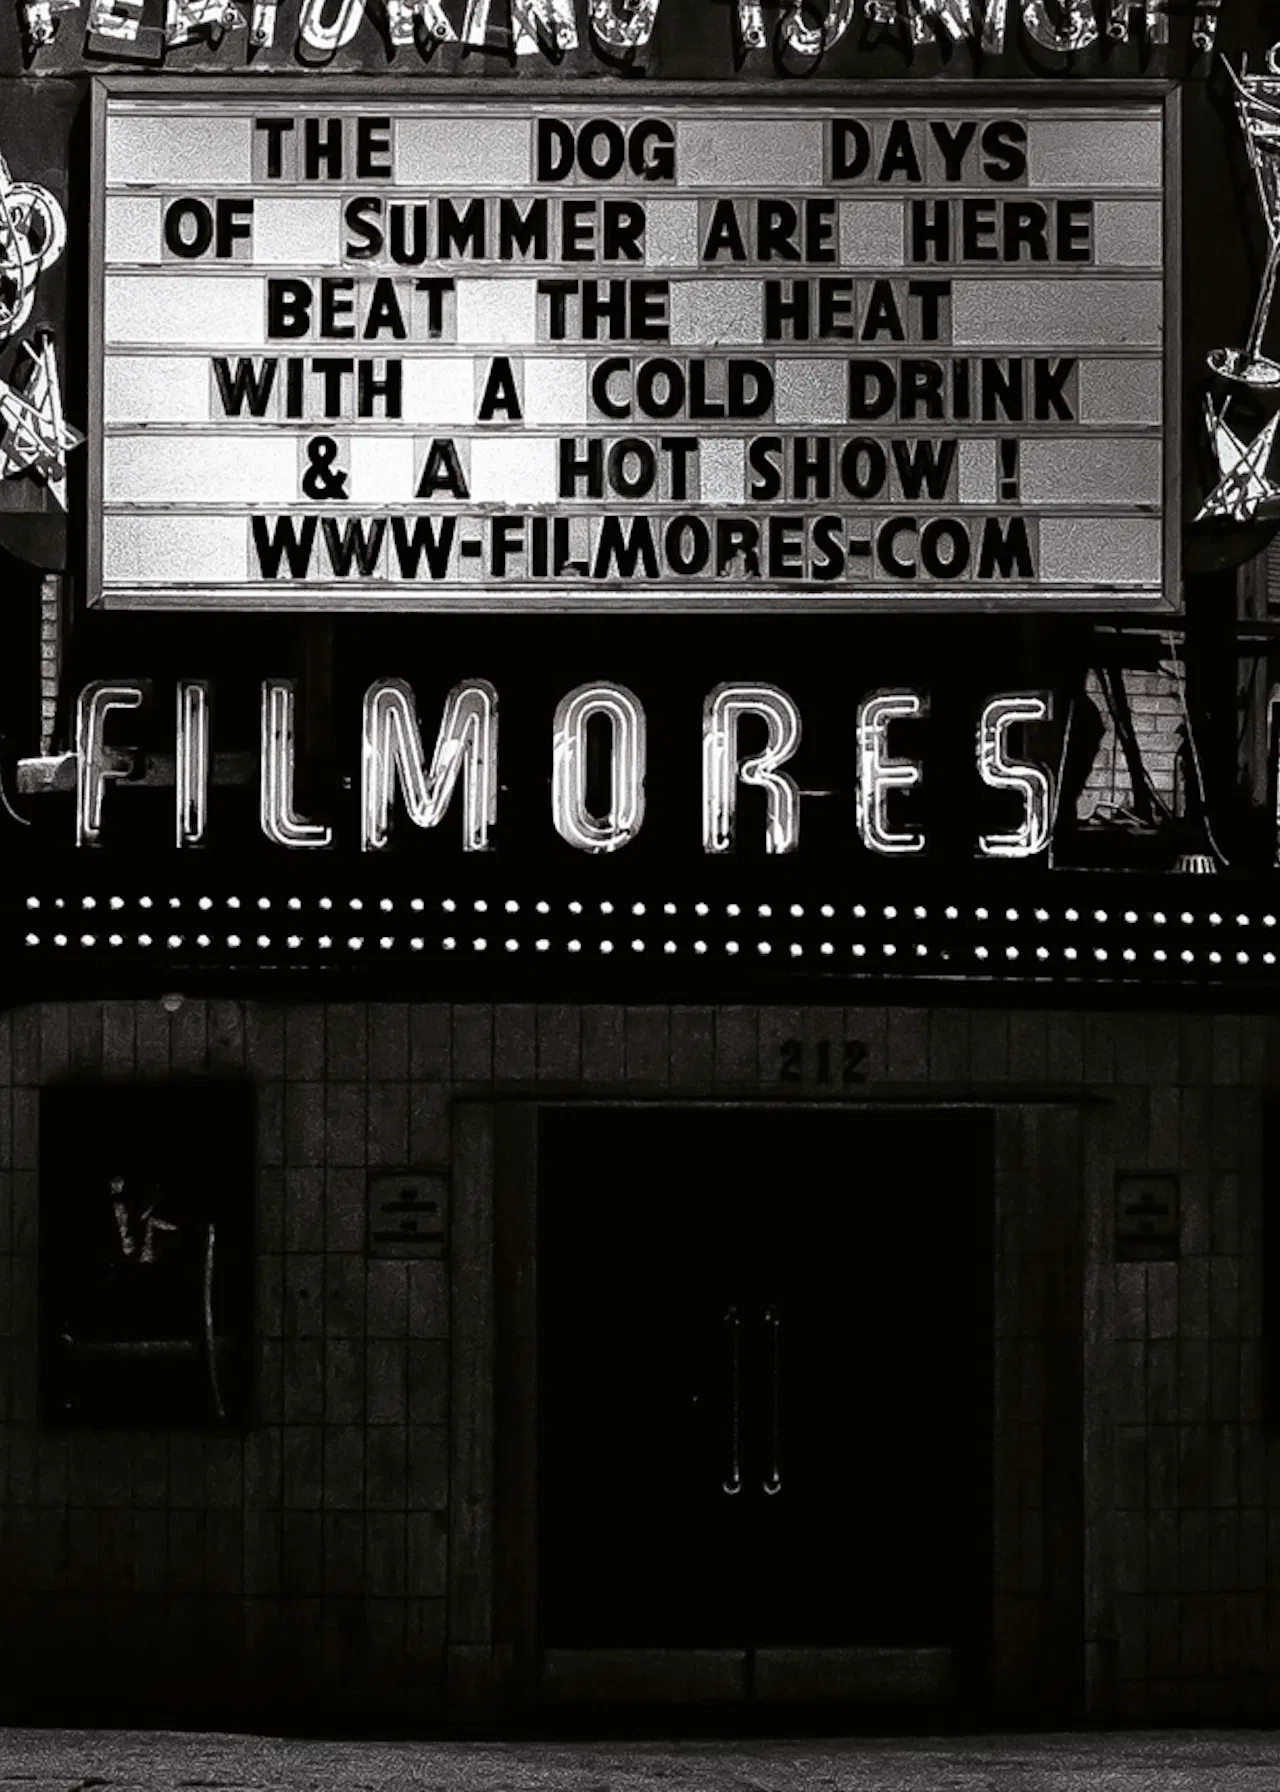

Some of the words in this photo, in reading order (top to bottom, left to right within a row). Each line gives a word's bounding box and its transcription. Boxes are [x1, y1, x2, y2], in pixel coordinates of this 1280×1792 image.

[256, 118, 391, 179] THE
[536, 119, 676, 181] DOG
[831, 119, 1029, 182] DAYS
[164, 198, 254, 258] OF
[344, 196, 646, 265] SUMMER
[703, 199, 837, 262] ARE
[911, 200, 1092, 262] HERE
[267, 277, 455, 339] BEAT
[536, 278, 670, 340] THE
[764, 280, 951, 341] HEAT
[211, 358, 403, 419] WITH
[477, 358, 523, 420] A
[591, 357, 775, 419] COLD
[848, 358, 1078, 421] DRINK
[302, 436, 349, 500] &
[415, 438, 470, 500] A
[557, 437, 698, 500] HOT
[747, 436, 957, 501] SHOW
[251, 515, 1035, 579] WWW-FILMORES-COM
[74, 677, 1056, 857] FILMORES
[780, 1039, 867, 1085] 212
